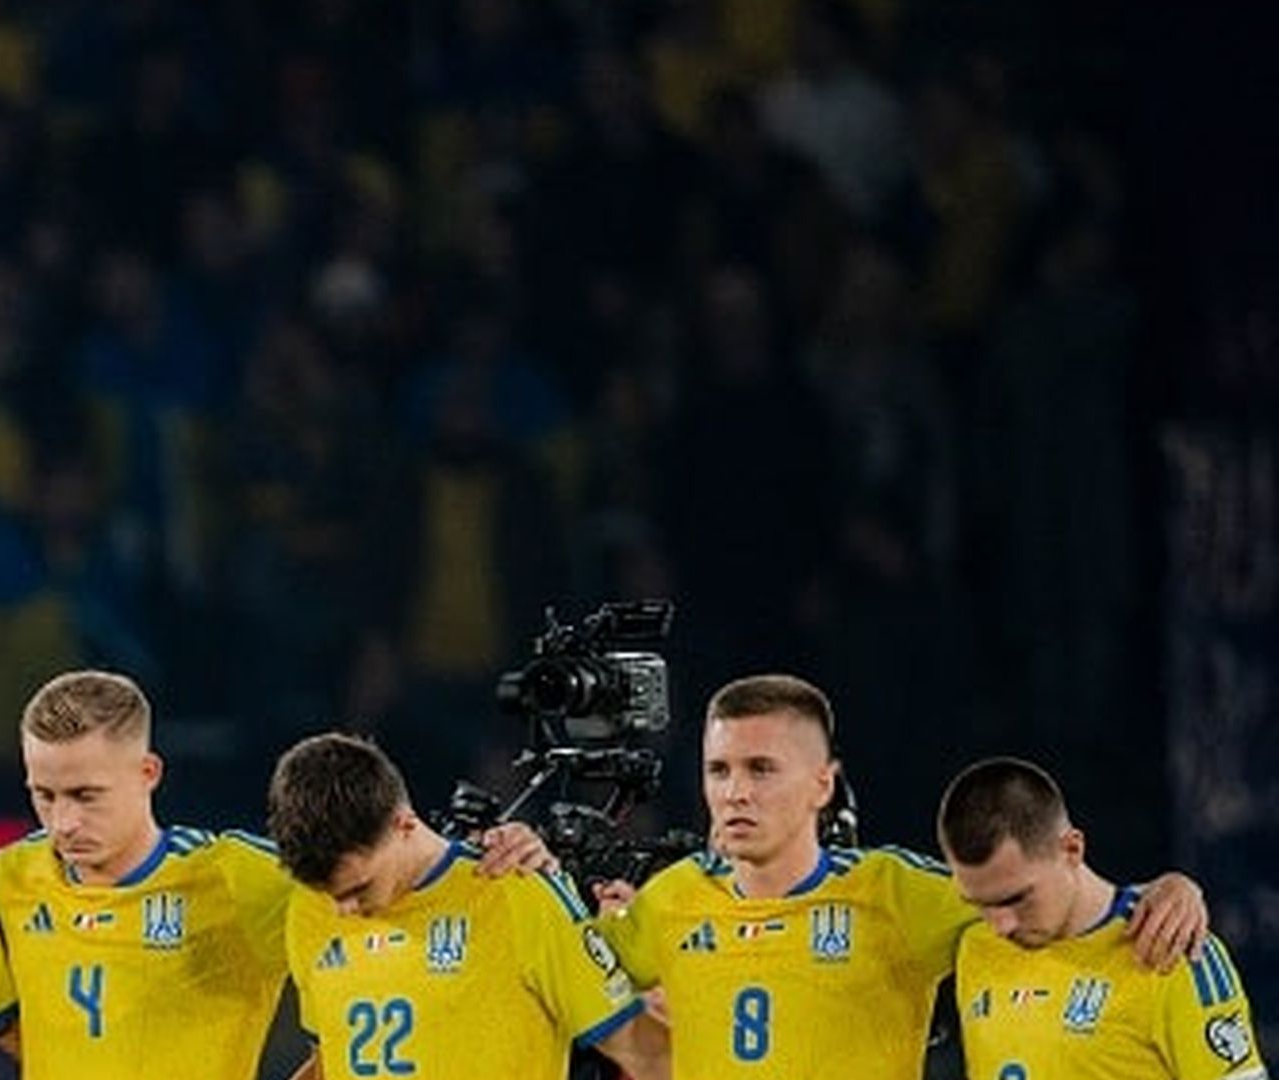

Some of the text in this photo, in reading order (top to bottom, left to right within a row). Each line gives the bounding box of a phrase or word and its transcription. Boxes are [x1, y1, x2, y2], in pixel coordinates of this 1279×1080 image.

[68, 964, 104, 1039] 4
[347, 997, 417, 1078] 22
[732, 986, 771, 1063] 8
